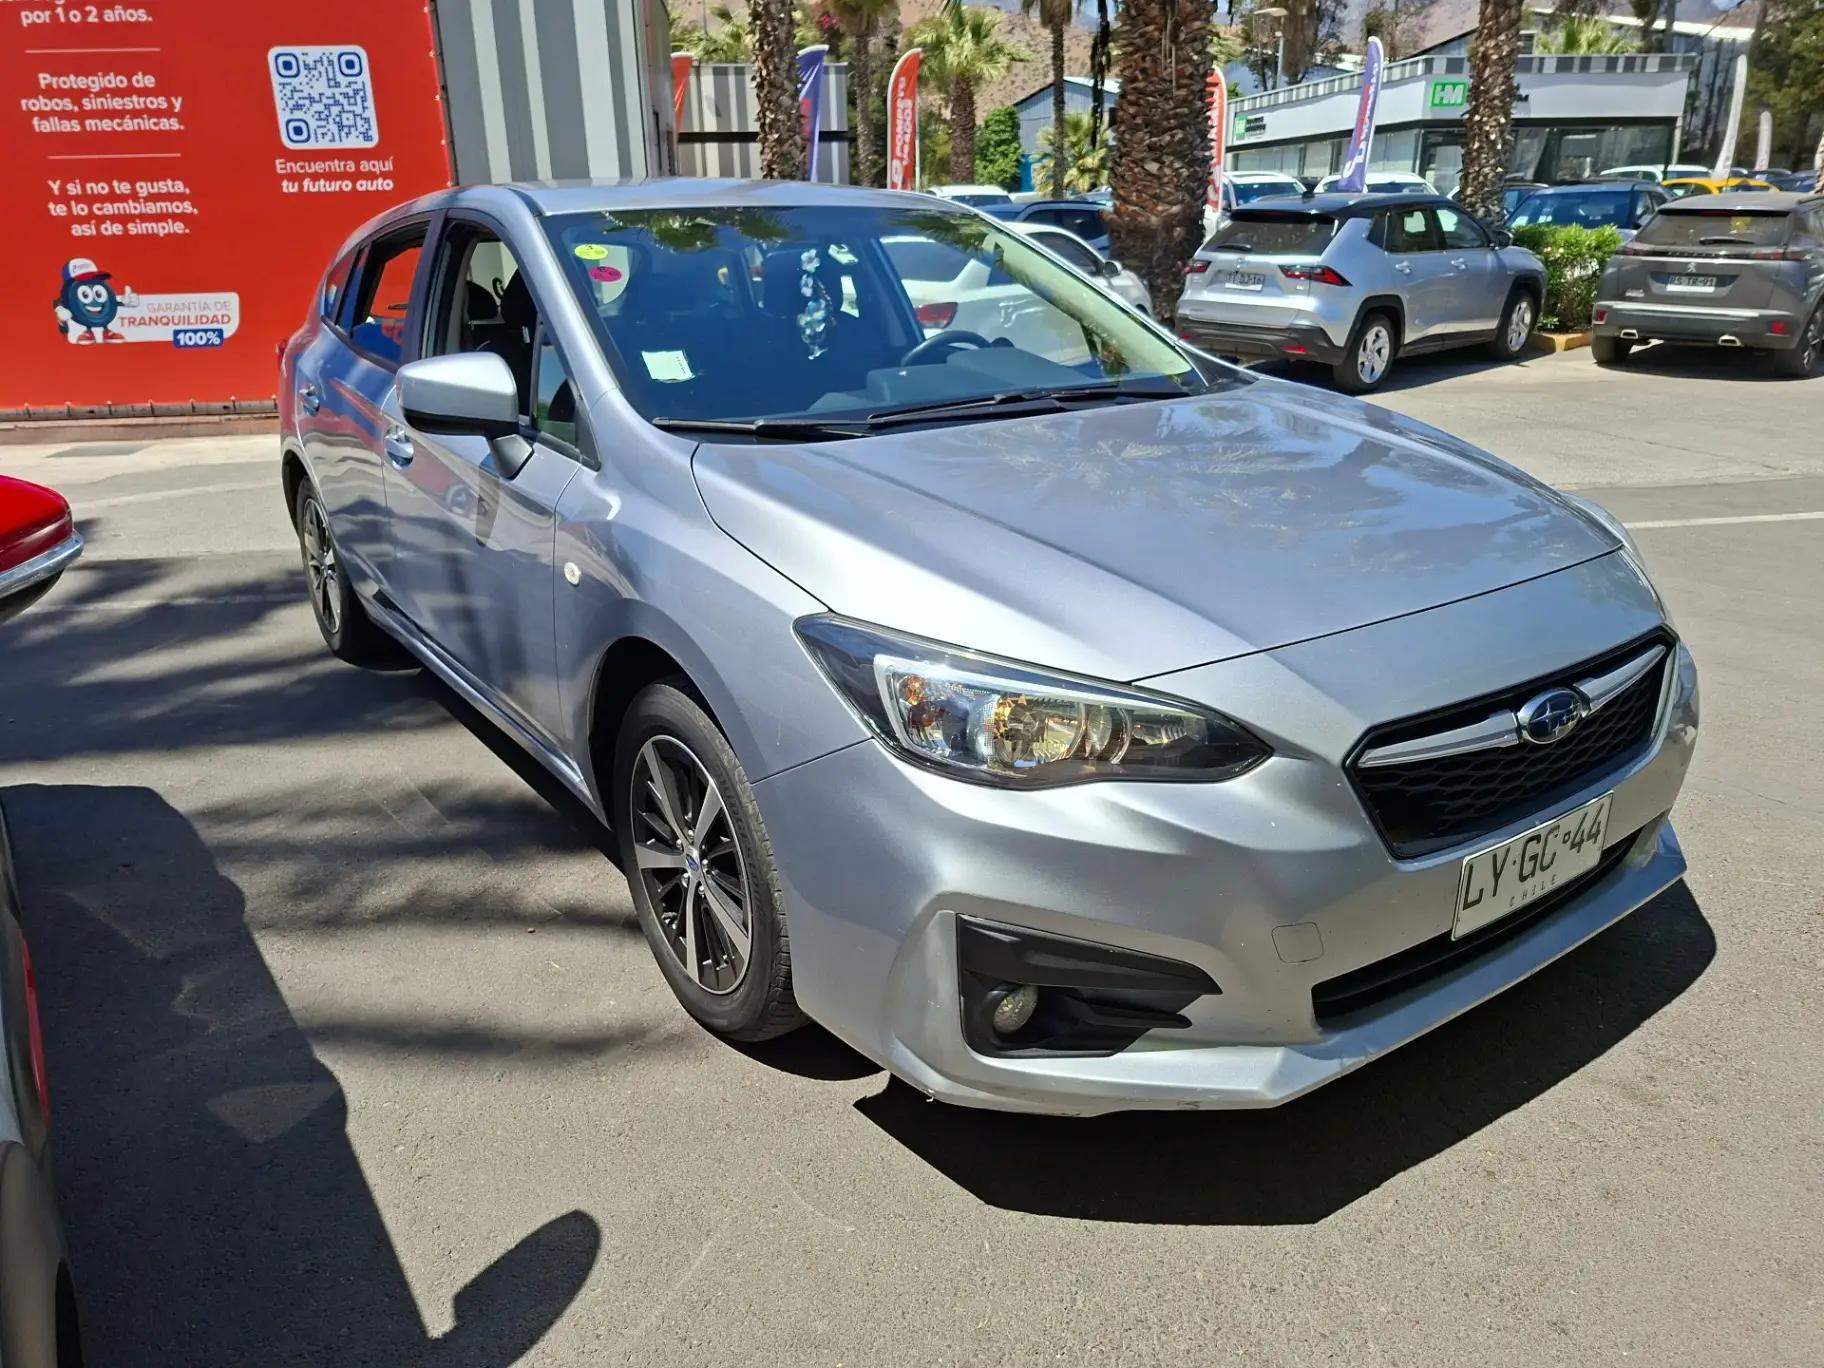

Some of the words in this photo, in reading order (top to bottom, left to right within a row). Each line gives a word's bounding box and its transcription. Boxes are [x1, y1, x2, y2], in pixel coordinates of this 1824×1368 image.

[20, 10, 51, 27] por
[56, 7, 65, 23] 1
[69, 10, 81, 23] o
[85, 5, 99, 23] 2
[103, 5, 152, 22] años.
[38, 72, 128, 91] Protegido
[132, 72, 156, 88] de
[20, 95, 79, 112] robos,
[82, 94, 168, 110] siniestros
[171, 96, 182, 112] y
[32, 116, 81, 133] fallas
[85, 115, 184, 132] mecánicas.
[275, 158, 355, 174] Encuentra
[359, 156, 394, 175] aquí
[48, 180, 61, 195] Y
[66, 179, 82, 195] si
[86, 182, 108, 194] no
[112, 179, 131, 194] te
[135, 178, 190, 197] gusta,
[281, 179, 298, 192] tu
[303, 178, 352, 192] futuro
[355, 177, 394, 191] auto
[48, 201, 67, 216] te
[72, 201, 88, 216] lo
[92, 199, 198, 215] cambiamos,
[71, 220, 96, 236] así
[100, 220, 124, 235] de
[127, 219, 190, 237] simple.
[212, 301, 231, 311] DE
[118, 314, 231, 328] TRANQUILIDAD
[176, 332, 221, 346] 100%
